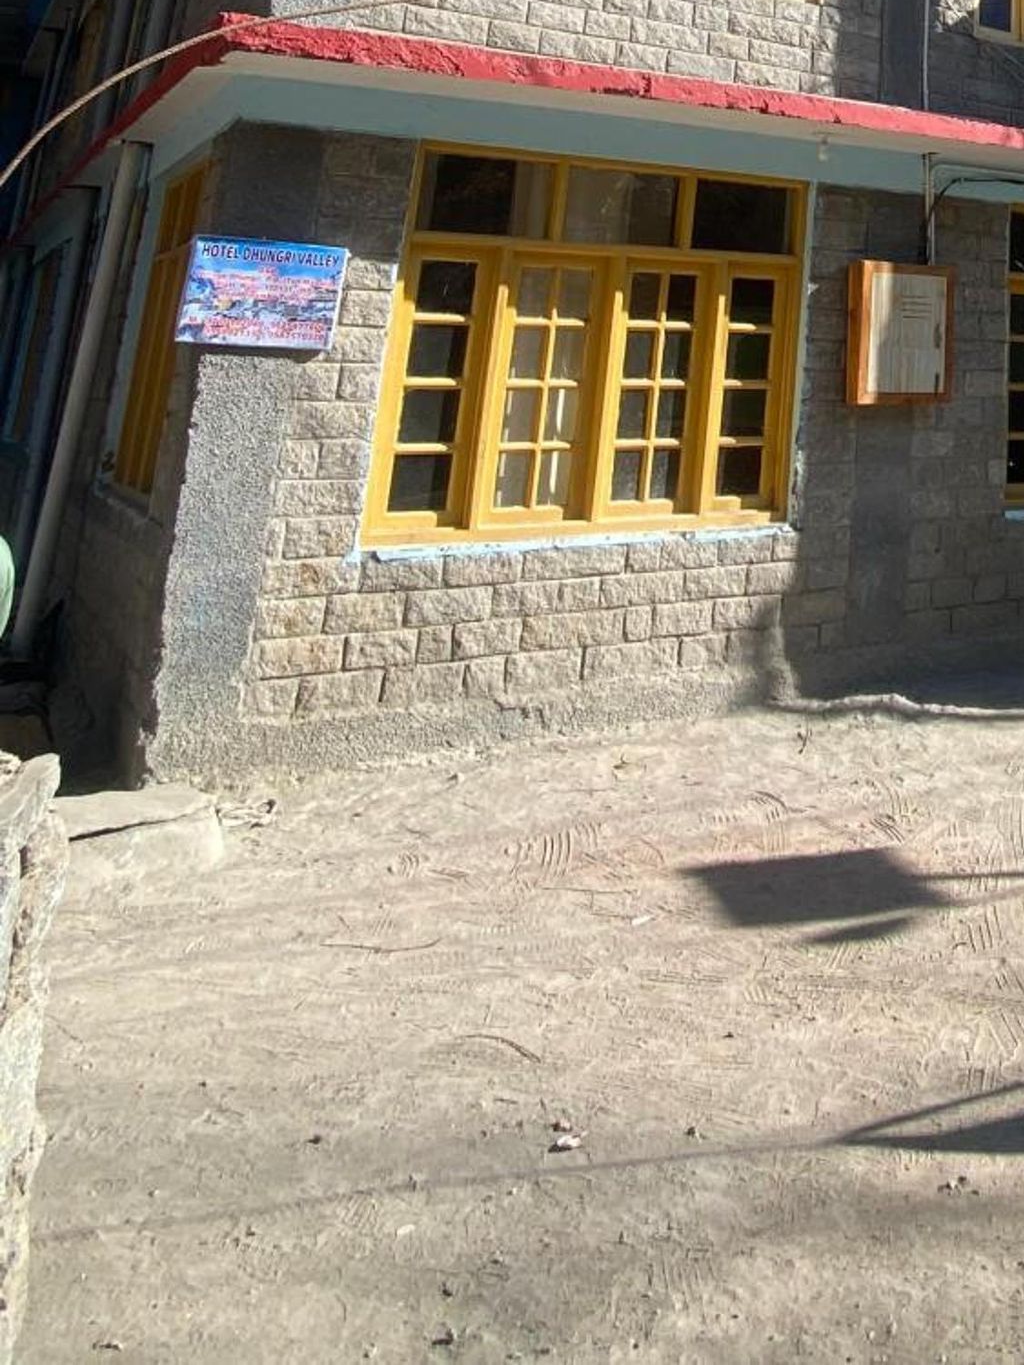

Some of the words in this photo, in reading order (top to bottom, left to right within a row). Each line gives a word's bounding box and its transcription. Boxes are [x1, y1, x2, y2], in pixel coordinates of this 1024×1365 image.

[202, 242, 240, 260] HOTEL
[243, 247, 295, 264] DHUNGRI
[297, 252, 340, 268] VALLEY
